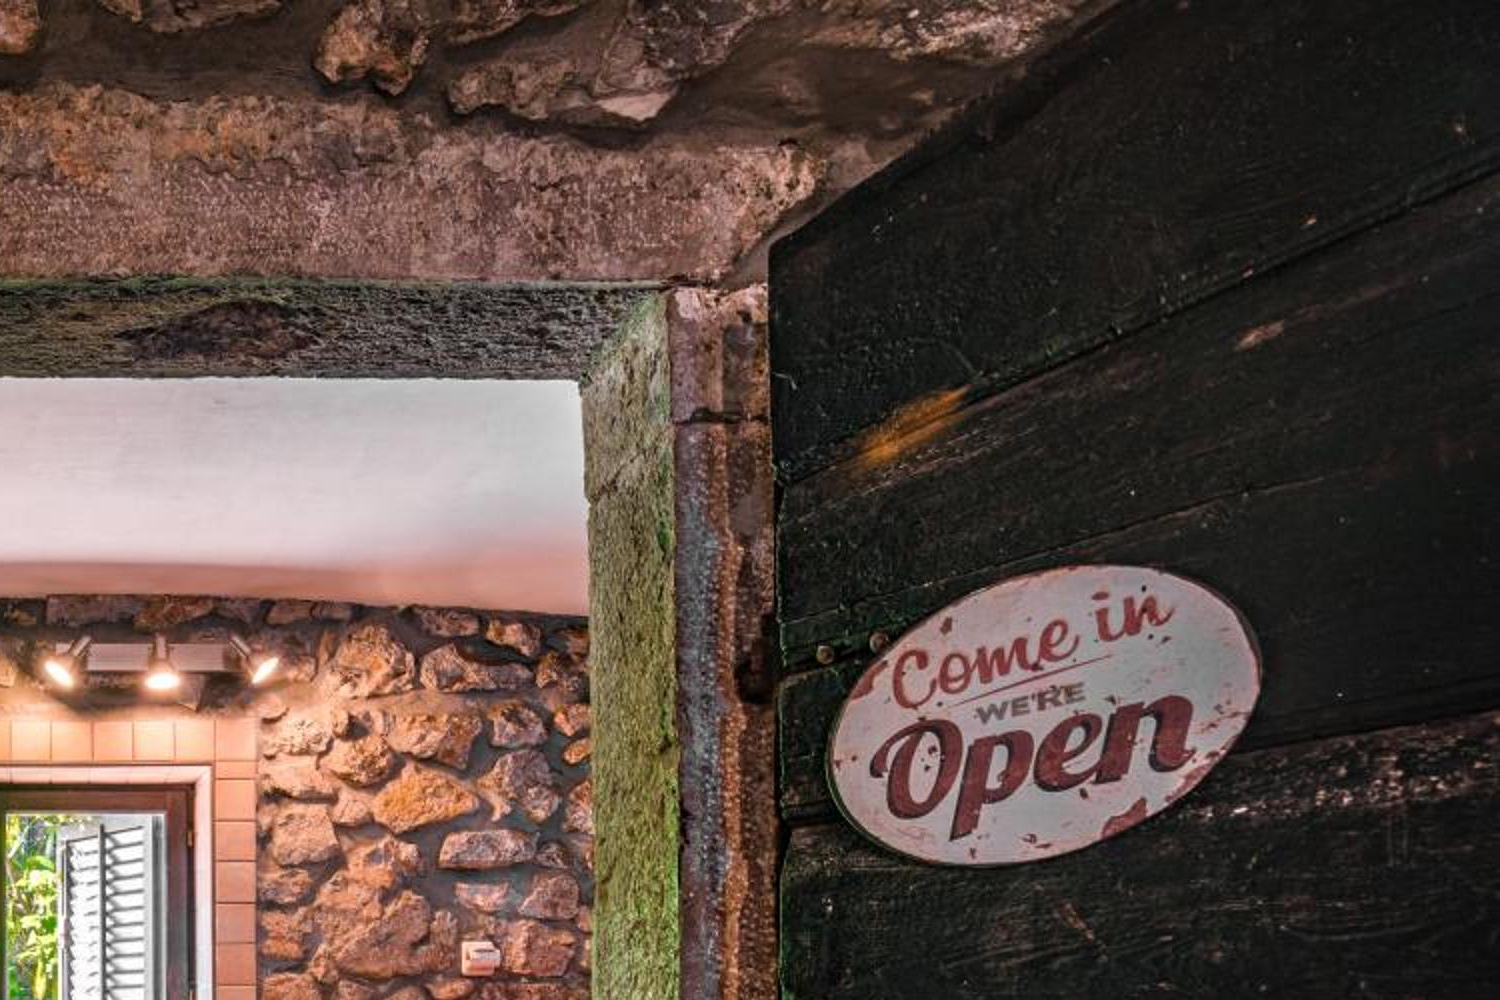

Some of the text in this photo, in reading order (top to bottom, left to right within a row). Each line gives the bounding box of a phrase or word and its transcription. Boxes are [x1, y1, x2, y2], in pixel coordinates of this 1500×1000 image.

[891, 588, 1175, 709] Come in
[975, 681, 1088, 725] WE'RE
[870, 694, 1197, 842] Open
